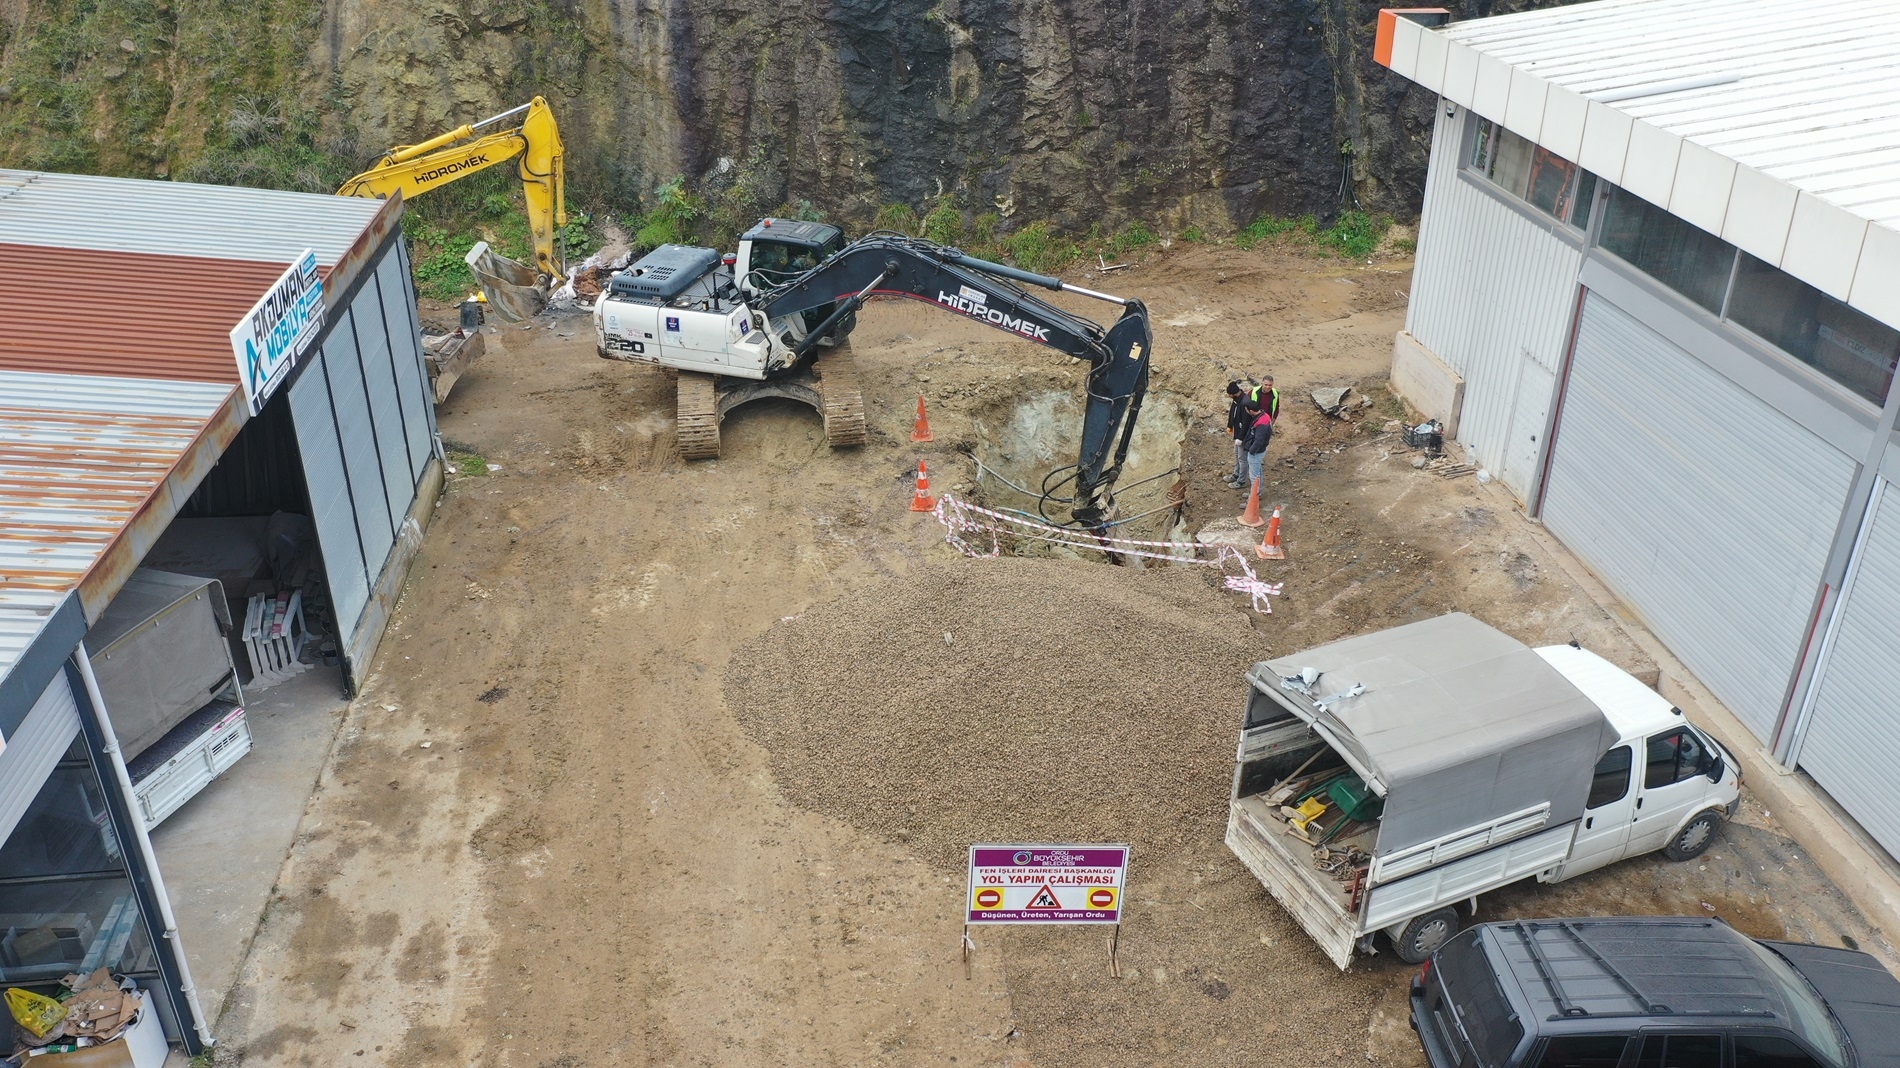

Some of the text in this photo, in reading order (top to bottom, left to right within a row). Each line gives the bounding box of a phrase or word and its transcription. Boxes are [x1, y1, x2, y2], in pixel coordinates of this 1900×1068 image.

[981, 875, 1114, 886] YOL YAPIM ÇALIŞMASI
